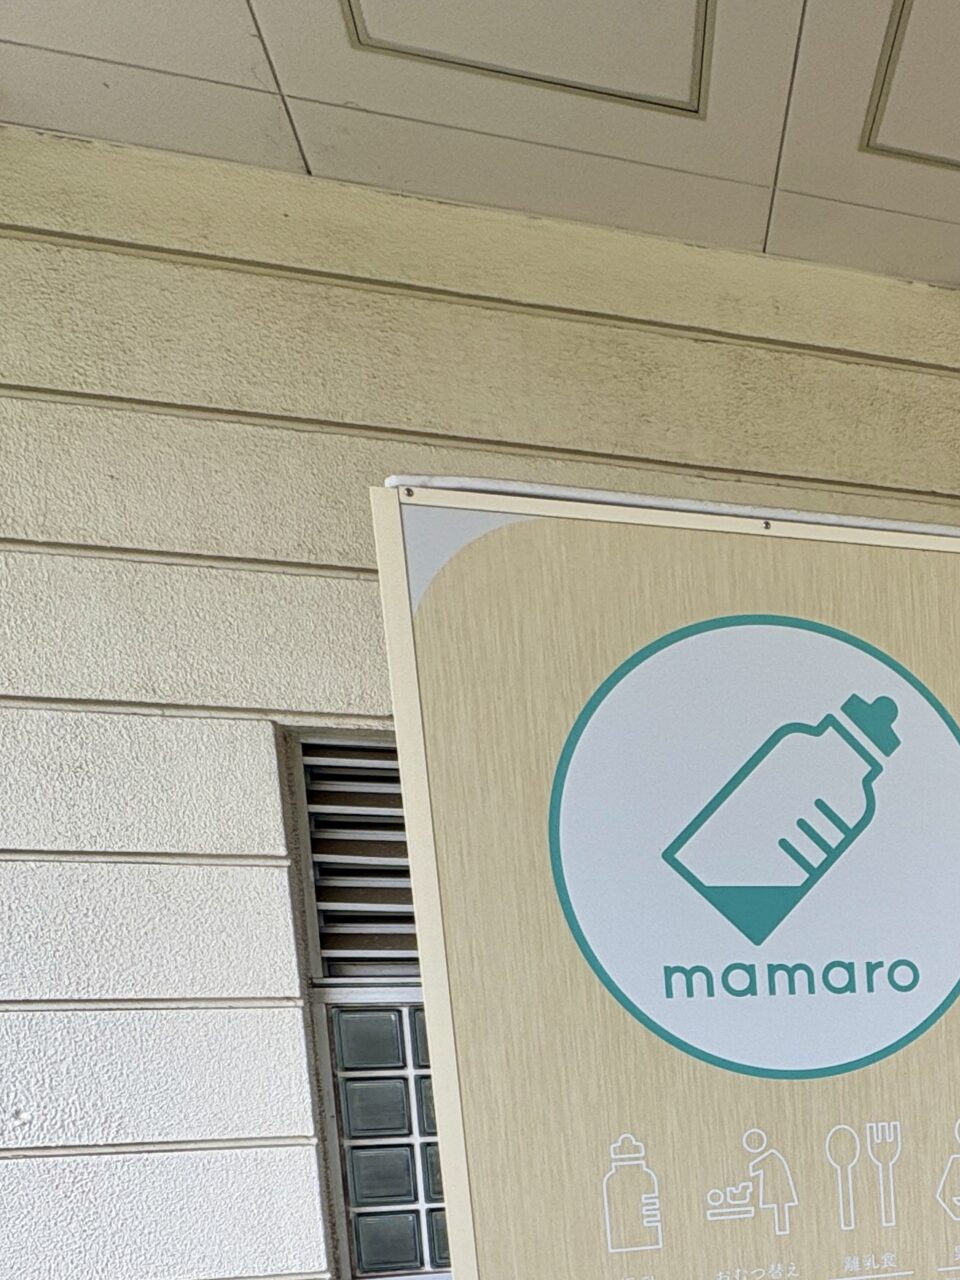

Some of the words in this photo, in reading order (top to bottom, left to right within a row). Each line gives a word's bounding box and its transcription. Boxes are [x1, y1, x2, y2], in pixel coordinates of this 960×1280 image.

[663, 958, 920, 999] mamaro
[844, 1251, 897, 1272] 離乳食
